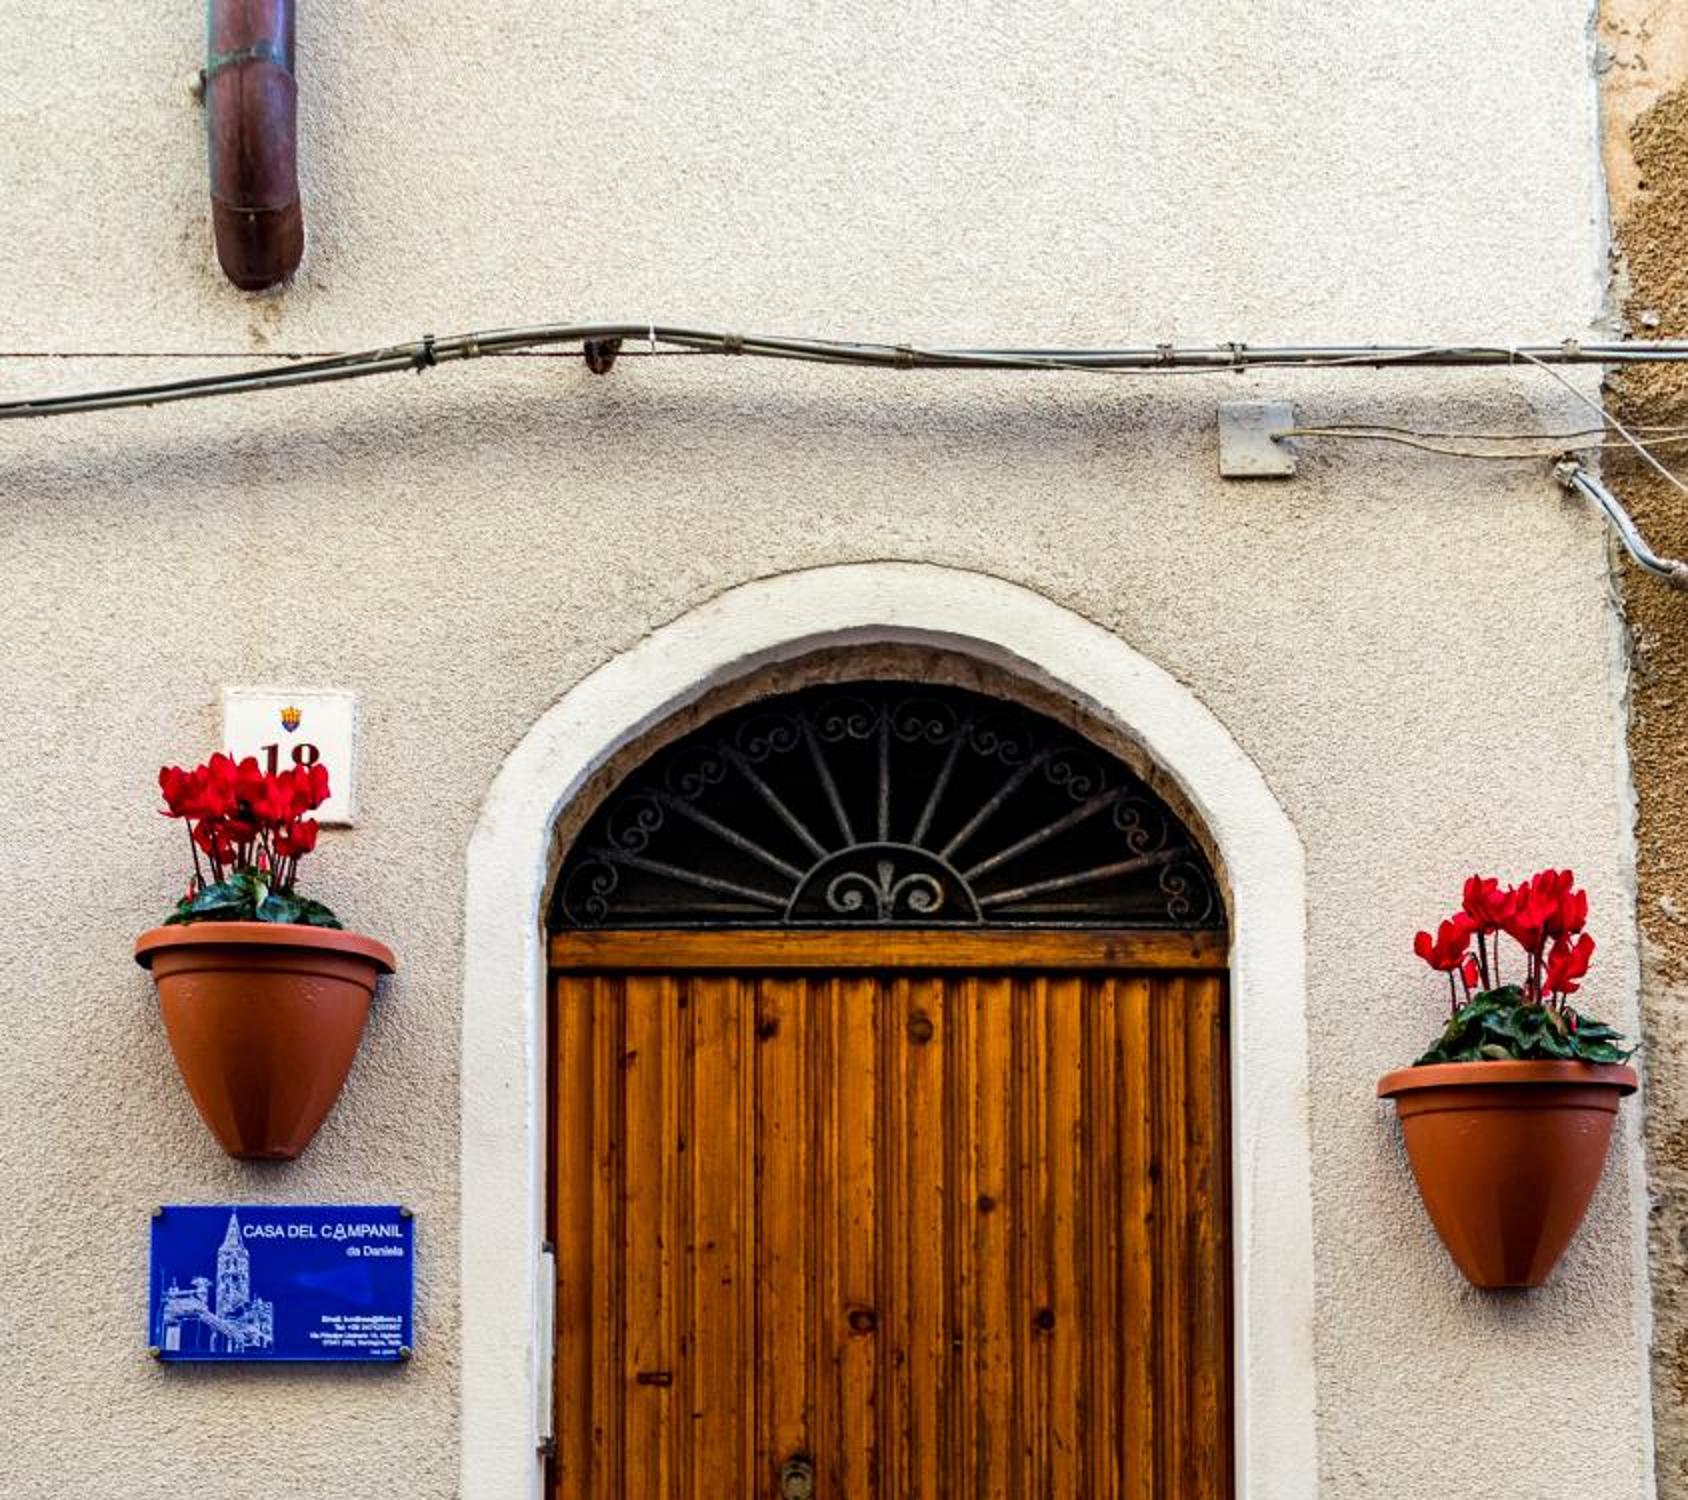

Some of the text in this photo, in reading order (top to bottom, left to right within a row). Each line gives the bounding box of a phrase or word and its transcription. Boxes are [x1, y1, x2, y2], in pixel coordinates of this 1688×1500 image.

[243, 1224, 285, 1238] CASA
[287, 1224, 318, 1238] DEL
[346, 1245, 404, 1257] da Daniela
